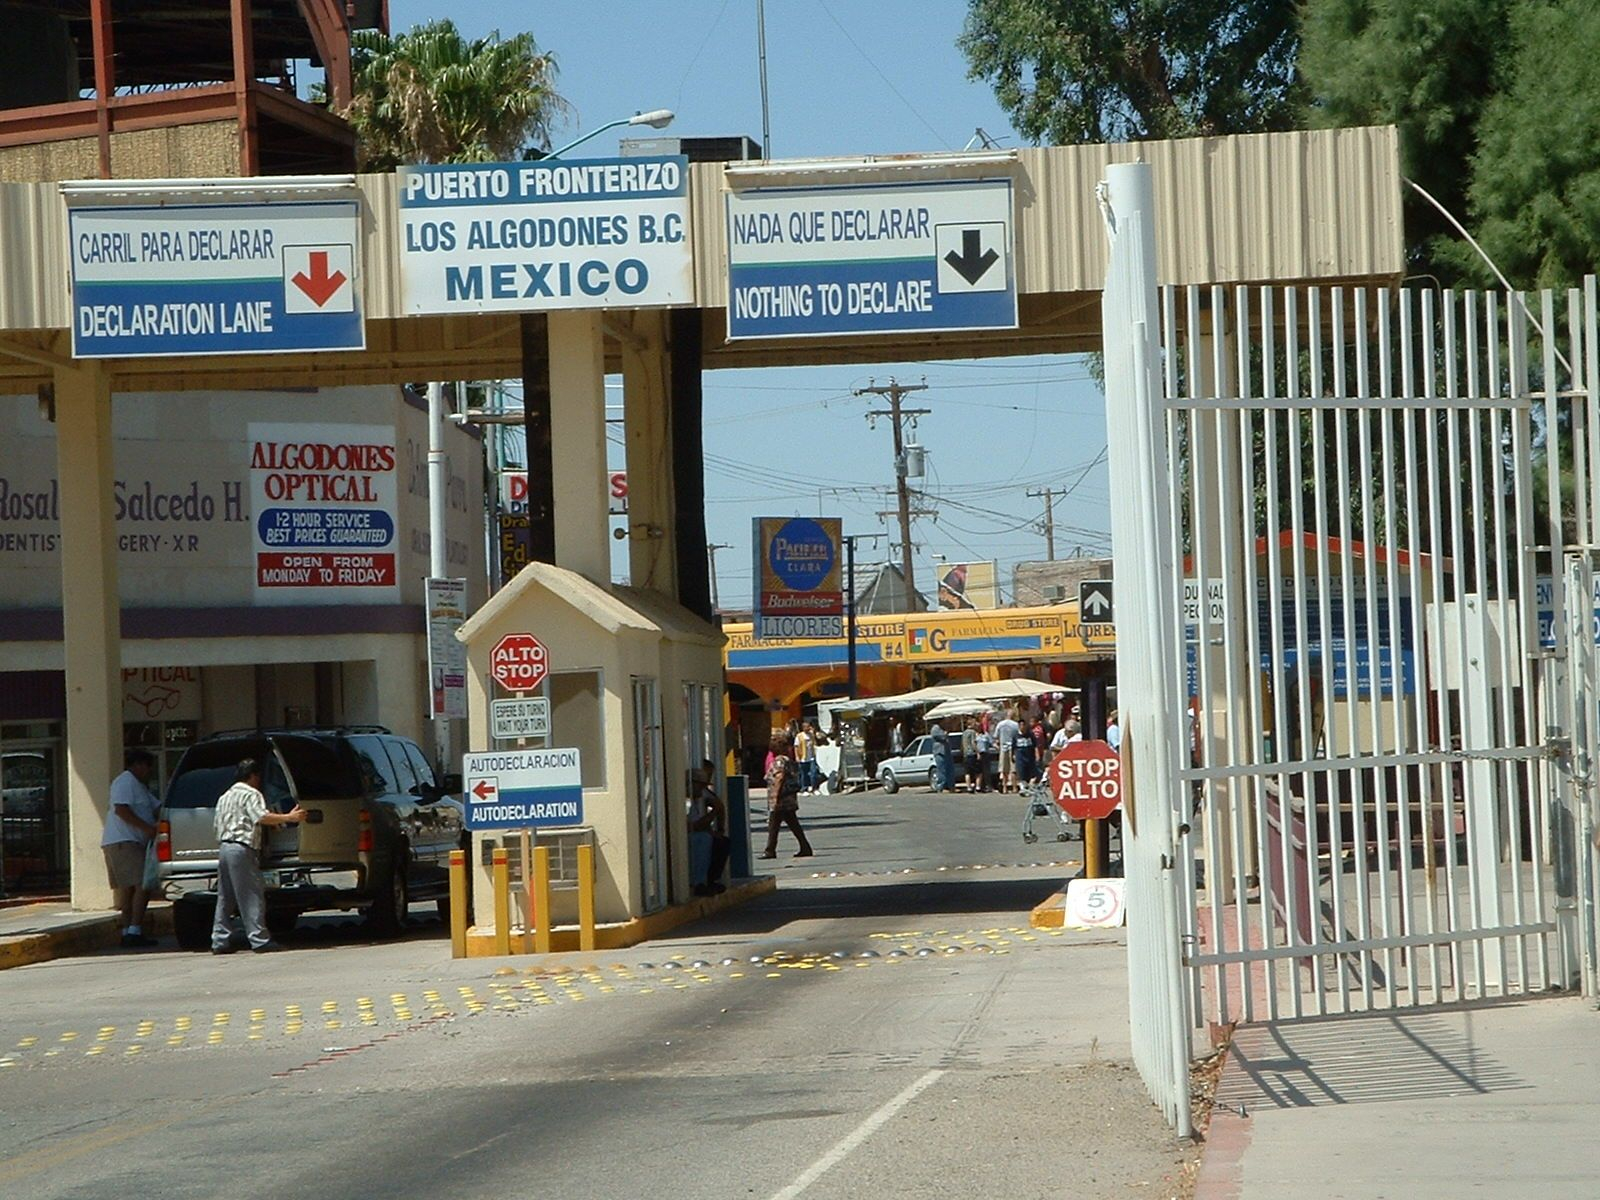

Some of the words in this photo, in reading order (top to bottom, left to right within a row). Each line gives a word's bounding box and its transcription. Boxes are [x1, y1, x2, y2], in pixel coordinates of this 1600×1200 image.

[406, 169, 510, 201] PUERTO
[519, 162, 680, 197] FRONTERIZO
[405, 221, 456, 252] LOS
[467, 215, 628, 250] ALGODONES
[638, 213, 686, 244] B.C.
[734, 213, 783, 245] NADA
[789, 211, 825, 244] QUE
[832, 208, 930, 241] DECLARAR
[79, 232, 137, 264] CARRIL
[141, 231, 185, 262] PARA
[189, 229, 274, 261] DECLARAR
[445, 259, 649, 302] MEXICO
[735, 284, 813, 319] NOTHING
[818, 283, 843, 315] TO
[848, 280, 933, 314] DECLARE
[80, 303, 214, 337] DECLARATION
[221, 301, 273, 333] LANE
[250, 442, 395, 472] ALGODONES
[264, 474, 378, 502] OPTICAL
[276, 512, 290, 528] 1-2
[292, 512, 321, 528] HOUR
[325, 513, 370, 528] SERVICE
[118, 534, 161, 552] GERY
[266, 528, 291, 543] BEST
[294, 528, 326, 543] PRICES
[330, 528, 387, 543] GUARANTEED
[283, 556, 322, 567] OPEN
[333, 556, 373, 568] FROM
[262, 568, 311, 583] MONDAY
[319, 568, 333, 583] TO
[338, 568, 386, 582] FRIDAY
[767, 594, 835, 609] Budweiser
[763, 616, 842, 637] LICORES
[857, 623, 904, 637] STORE
[1031, 618, 1059, 627] STORE
[930, 629, 950, 651] G
[1044, 635, 1061, 646] #2
[496, 647, 543, 662] ALTO
[885, 642, 903, 658] #4
[122, 666, 196, 682] PTICAL
[496, 664, 544, 679] STOP
[513, 719, 530, 732] YOUR
[530, 718, 546, 730] TURN
[469, 752, 576, 773] AUTODECLARACION
[1058, 759, 1120, 779] STOP
[1058, 779, 1119, 800] ALTO
[471, 802, 577, 823] AUTODECLARATION
[1087, 892, 1105, 908] 5
